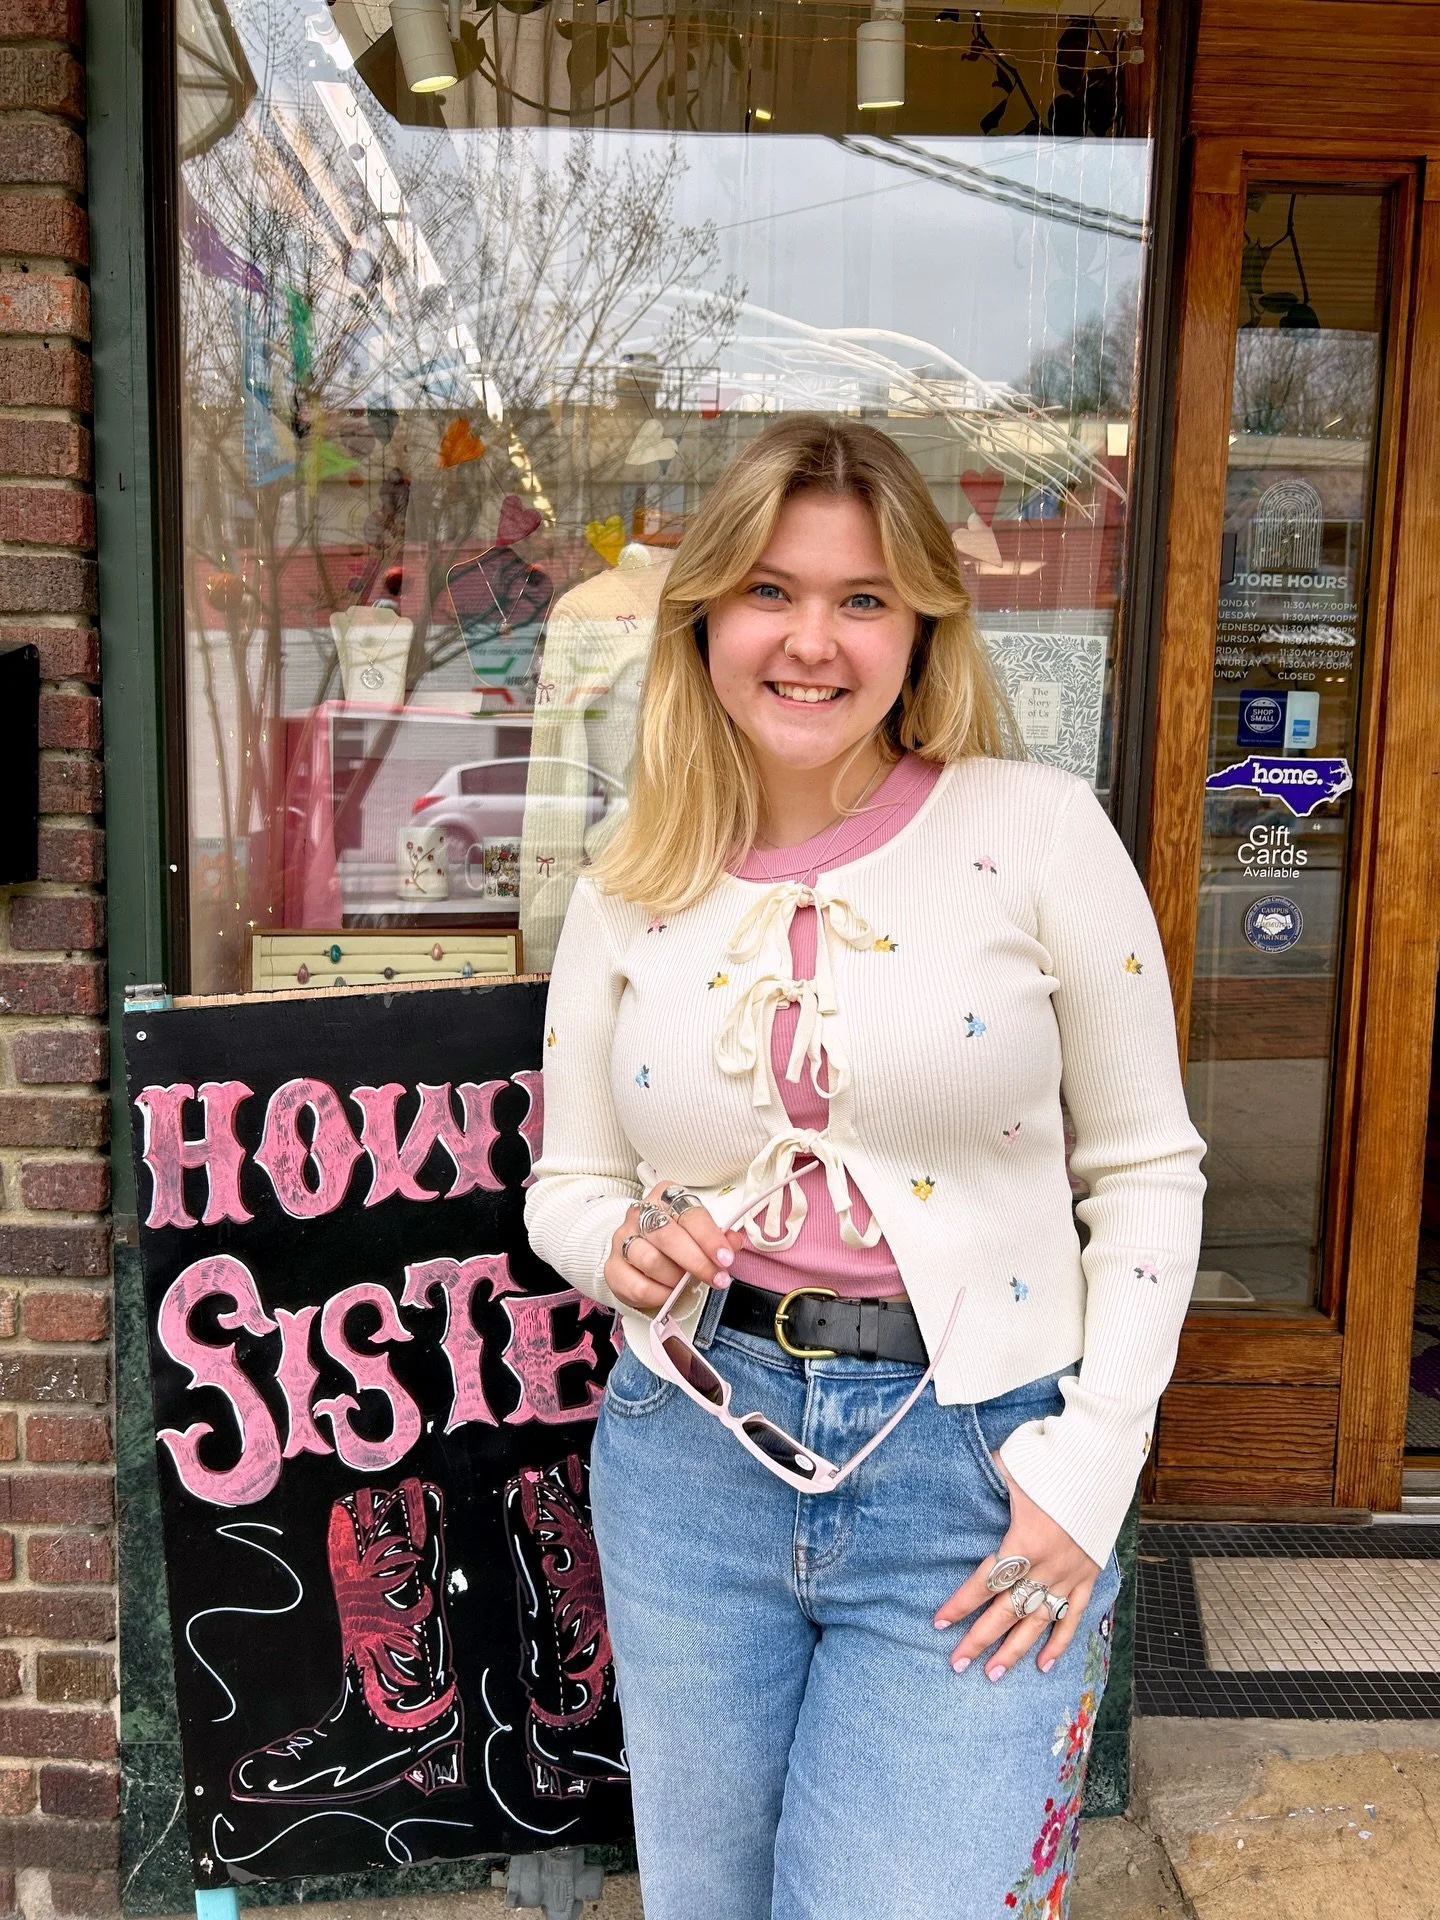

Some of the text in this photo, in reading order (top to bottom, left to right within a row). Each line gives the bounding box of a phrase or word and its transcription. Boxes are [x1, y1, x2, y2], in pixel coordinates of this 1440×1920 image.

[1288, 574, 1348, 589] HOURS
[1283, 601, 1357, 611] 11:30AM-7:00PM
[1218, 611, 1357, 623] UESDAY 11:30AM-7:00PM
[1216, 634, 1262, 644] HURSDAY
[1216, 646, 1354, 658] RIDAY 11:30AM-7:00PM
[1215, 657, 1262, 667] ATURDAY
[1278, 659, 1353, 670] 11:30AM-7:00PM
[1214, 670, 1316, 681] UNDAY CLOSED
[1032, 688, 1049, 697] The
[1028, 698, 1051, 709] Story
[1027, 709, 1049, 718] of Us
[1252, 708, 1274, 716] SHOP
[1251, 763, 1323, 785] home.
[1249, 824, 1290, 847] Gift
[1237, 843, 1308, 866] Cards
[1243, 866, 1300, 879] Available
[156, 1253, 624, 1508] SISTE
